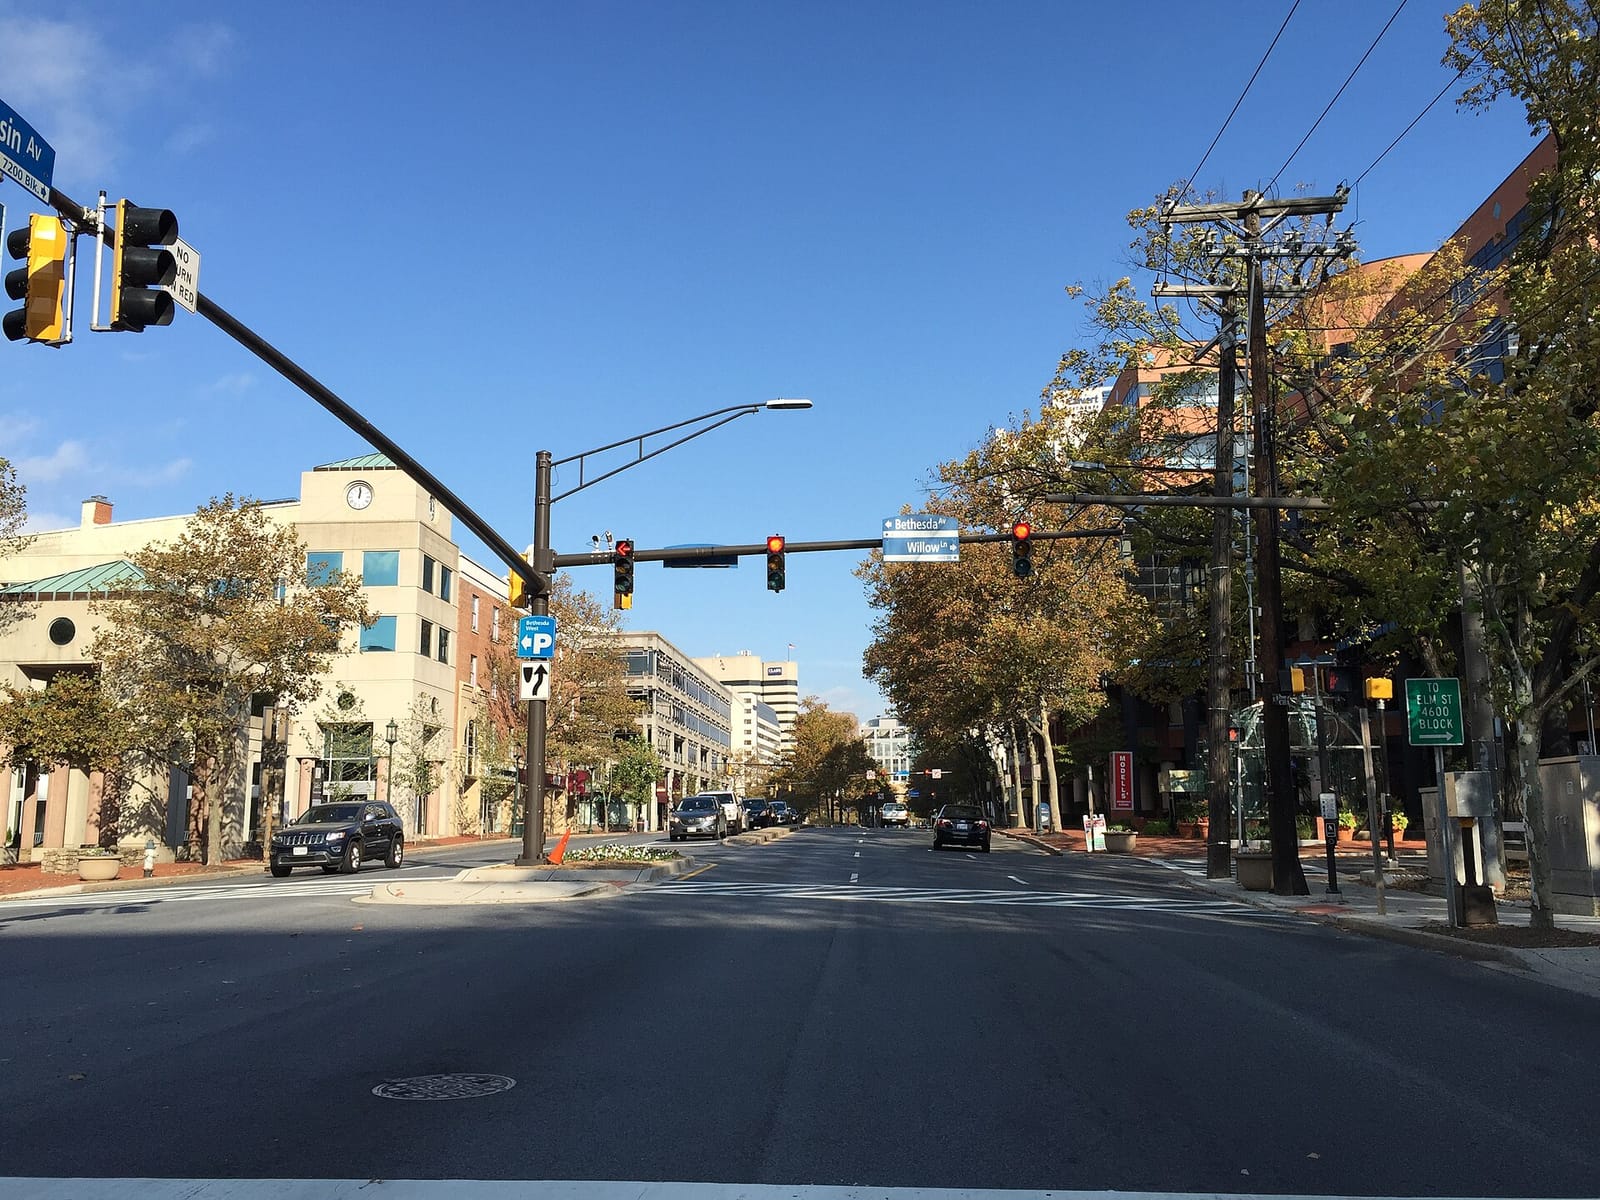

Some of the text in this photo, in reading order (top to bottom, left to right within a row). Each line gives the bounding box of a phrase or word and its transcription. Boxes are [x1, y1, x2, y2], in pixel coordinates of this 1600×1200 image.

[26, 136, 42, 161] Av
[3, 158, 39, 195] 7200 Blk.
[177, 246, 190, 263] NO
[175, 264, 192, 285] URN
[179, 285, 194, 306] RED
[895, 517, 947, 530] Bethesda Av
[907, 541, 940, 553] Willow
[532, 633, 553, 655] P
[1426, 682, 1439, 693] TO
[1416, 694, 1453, 705] ELM ST
[1421, 706, 1449, 717] 4600
[1419, 718, 1454, 730] BLOCK
